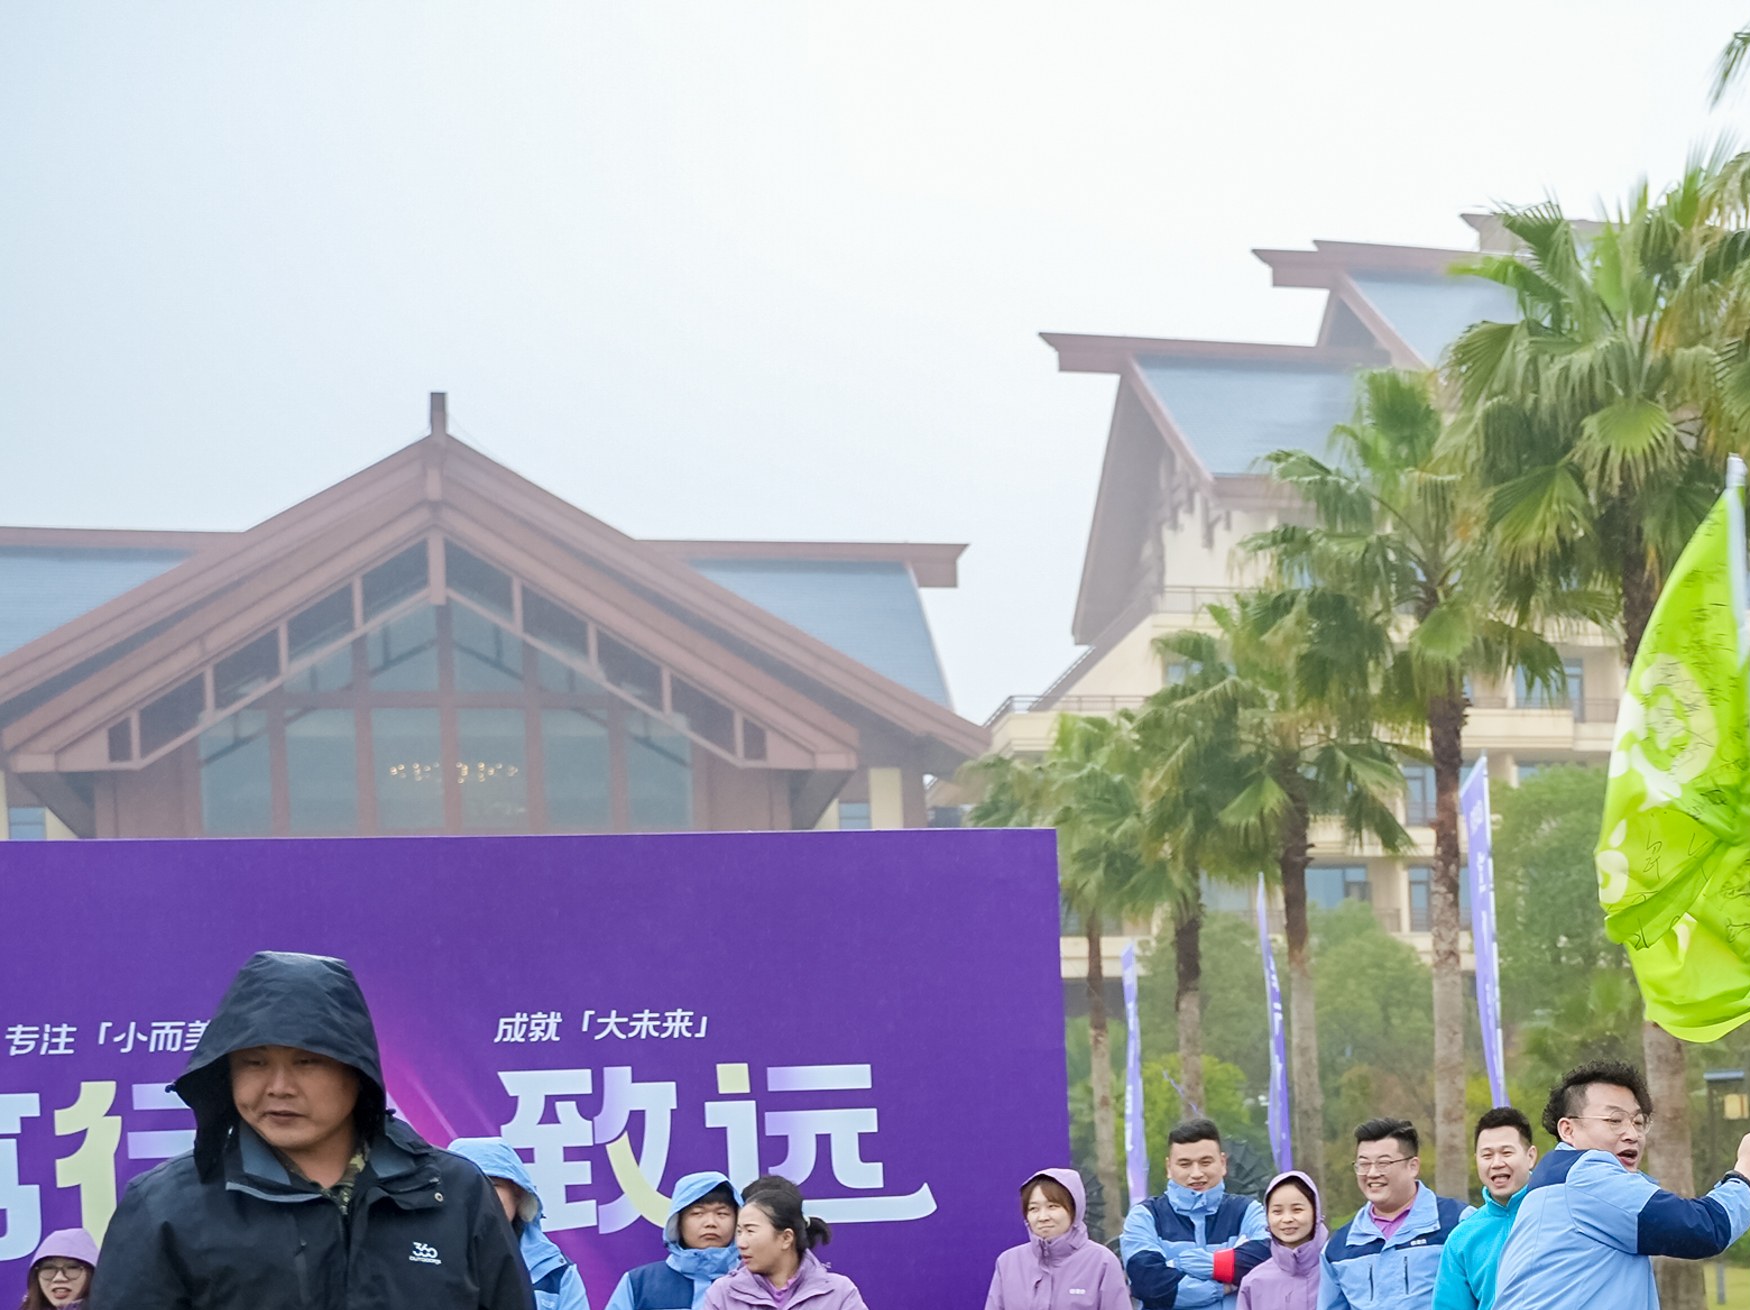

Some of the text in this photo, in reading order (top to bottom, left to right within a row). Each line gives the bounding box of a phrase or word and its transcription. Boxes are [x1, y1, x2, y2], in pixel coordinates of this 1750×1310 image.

[493, 1008, 708, 1043] 成就「大未来」
[497, 1062, 938, 1235] 致远
[412, 1241, 439, 1259] 360
